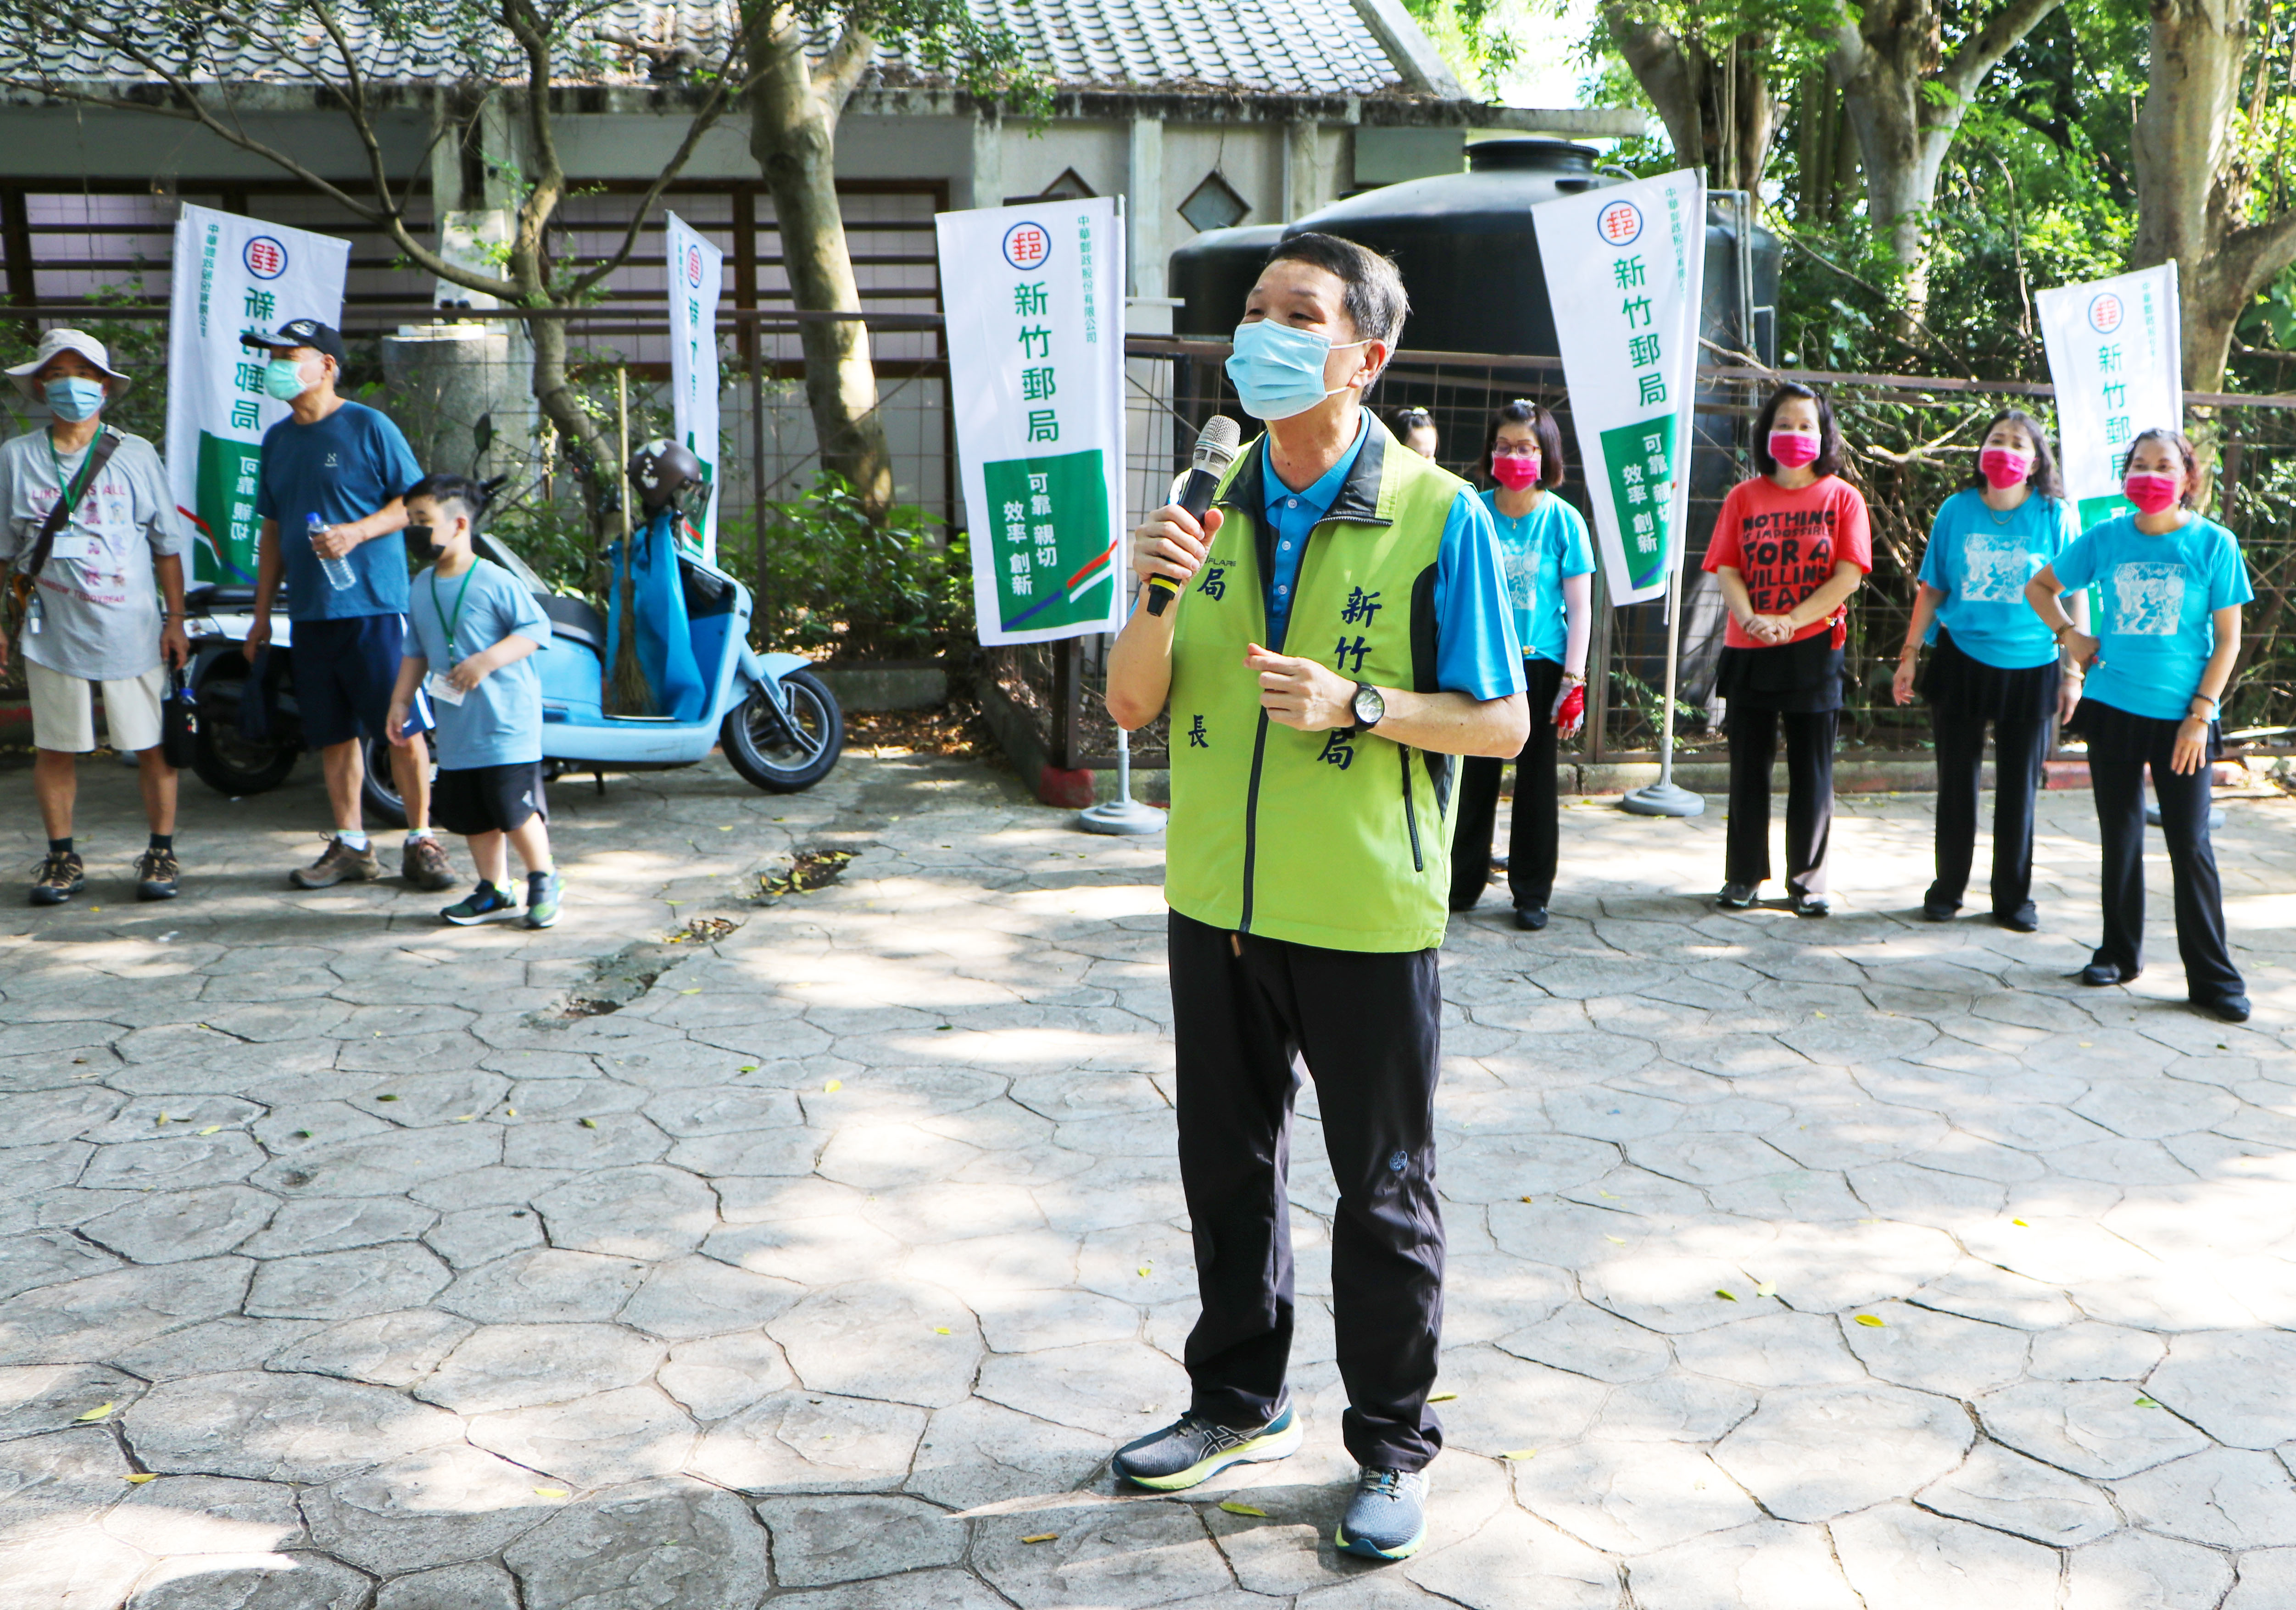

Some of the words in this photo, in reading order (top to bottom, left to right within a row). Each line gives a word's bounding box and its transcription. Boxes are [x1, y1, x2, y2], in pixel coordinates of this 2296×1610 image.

[1606, 207, 1636, 239] 郵
[1013, 230, 1042, 261] 郵
[1078, 215, 1097, 343] 中華郵政股份有限公司
[1613, 254, 1667, 407] 新竹郵局
[2096, 299, 2118, 327] 郵
[1014, 281, 1059, 443] 新竹郵局
[1643, 433, 1668, 475] 可靠
[103, 484, 126, 496] ALL
[1028, 472, 1052, 516] 可靠
[1622, 463, 1648, 506] 效率
[1652, 480, 1672, 523] 親切
[1003, 500, 1027, 544] 效率
[1632, 511, 1658, 553] 創新
[1743, 511, 1835, 532] NOTHING
[1034, 524, 1057, 567] 親切
[1743, 539, 1800, 570] FOR
[1808, 539, 1830, 564] A
[1009, 552, 1032, 596] 創新
[1750, 584, 1819, 610] EAR
[1317, 585, 1383, 771] 新竹局
